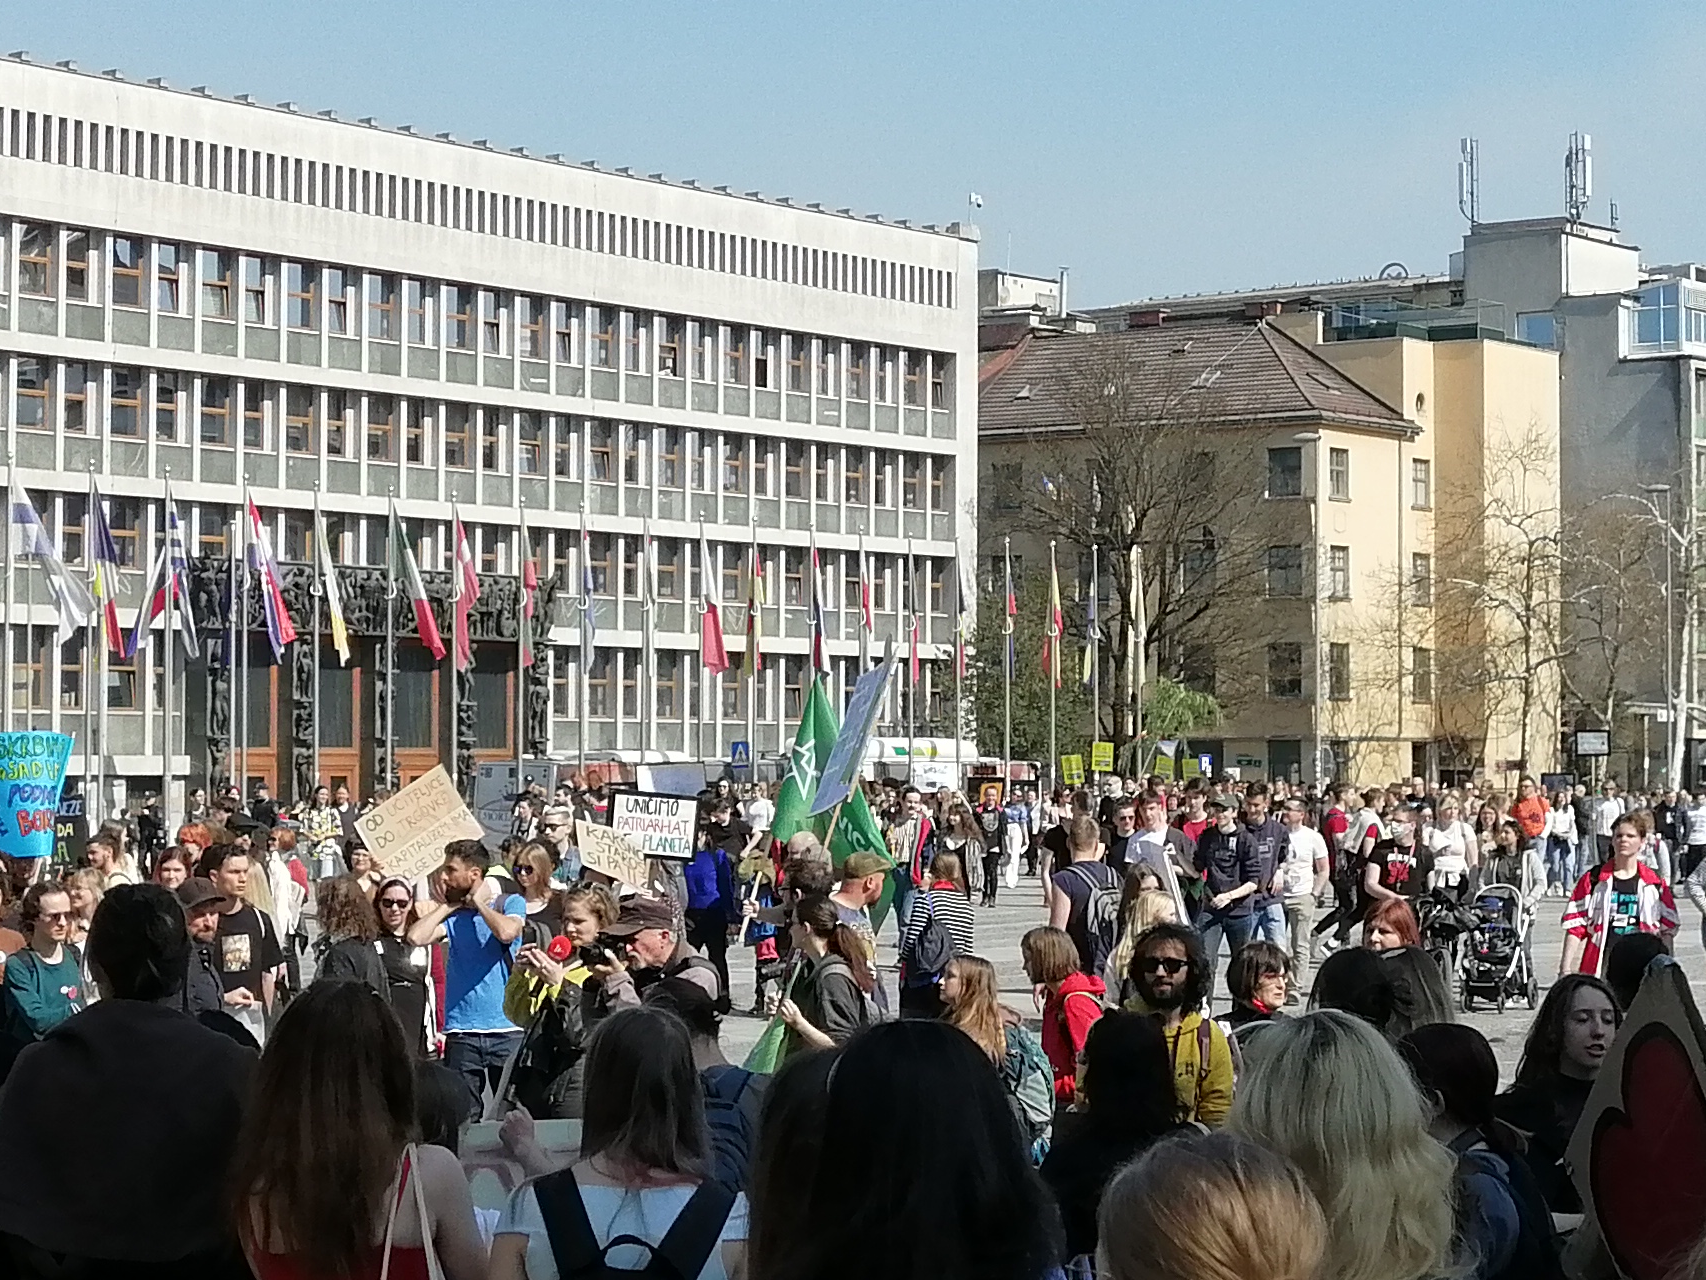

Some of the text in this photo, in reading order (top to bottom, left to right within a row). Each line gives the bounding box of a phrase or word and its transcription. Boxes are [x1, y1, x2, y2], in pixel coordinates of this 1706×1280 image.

[365, 813, 385, 832] OD
[375, 830, 395, 849] DO
[587, 851, 601, 867] SI
